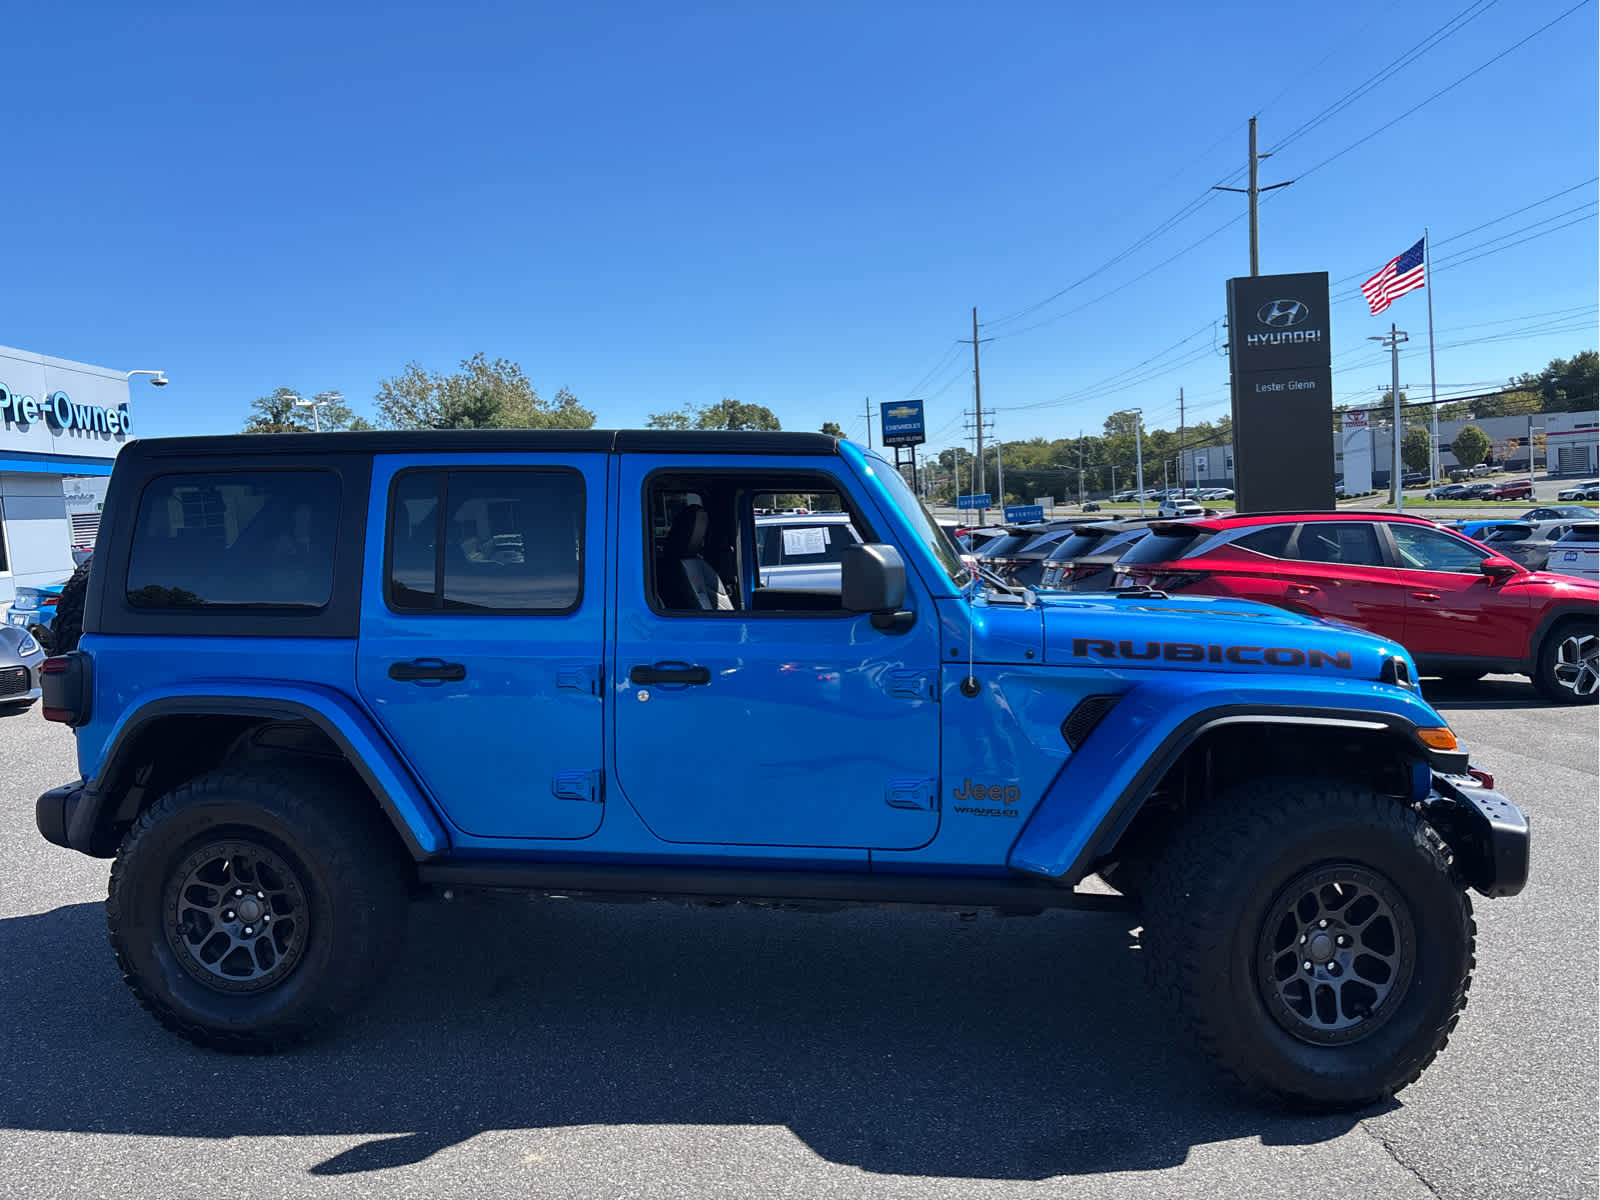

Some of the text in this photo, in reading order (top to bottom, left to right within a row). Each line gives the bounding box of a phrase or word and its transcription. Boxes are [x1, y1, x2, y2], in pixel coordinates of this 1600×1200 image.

[1247, 329, 1320, 346] HYUNDAI
[1255, 379, 1316, 393] Lester Glenn
[1072, 638, 1352, 670] RUBICON
[954, 778, 1020, 806] Jeep
